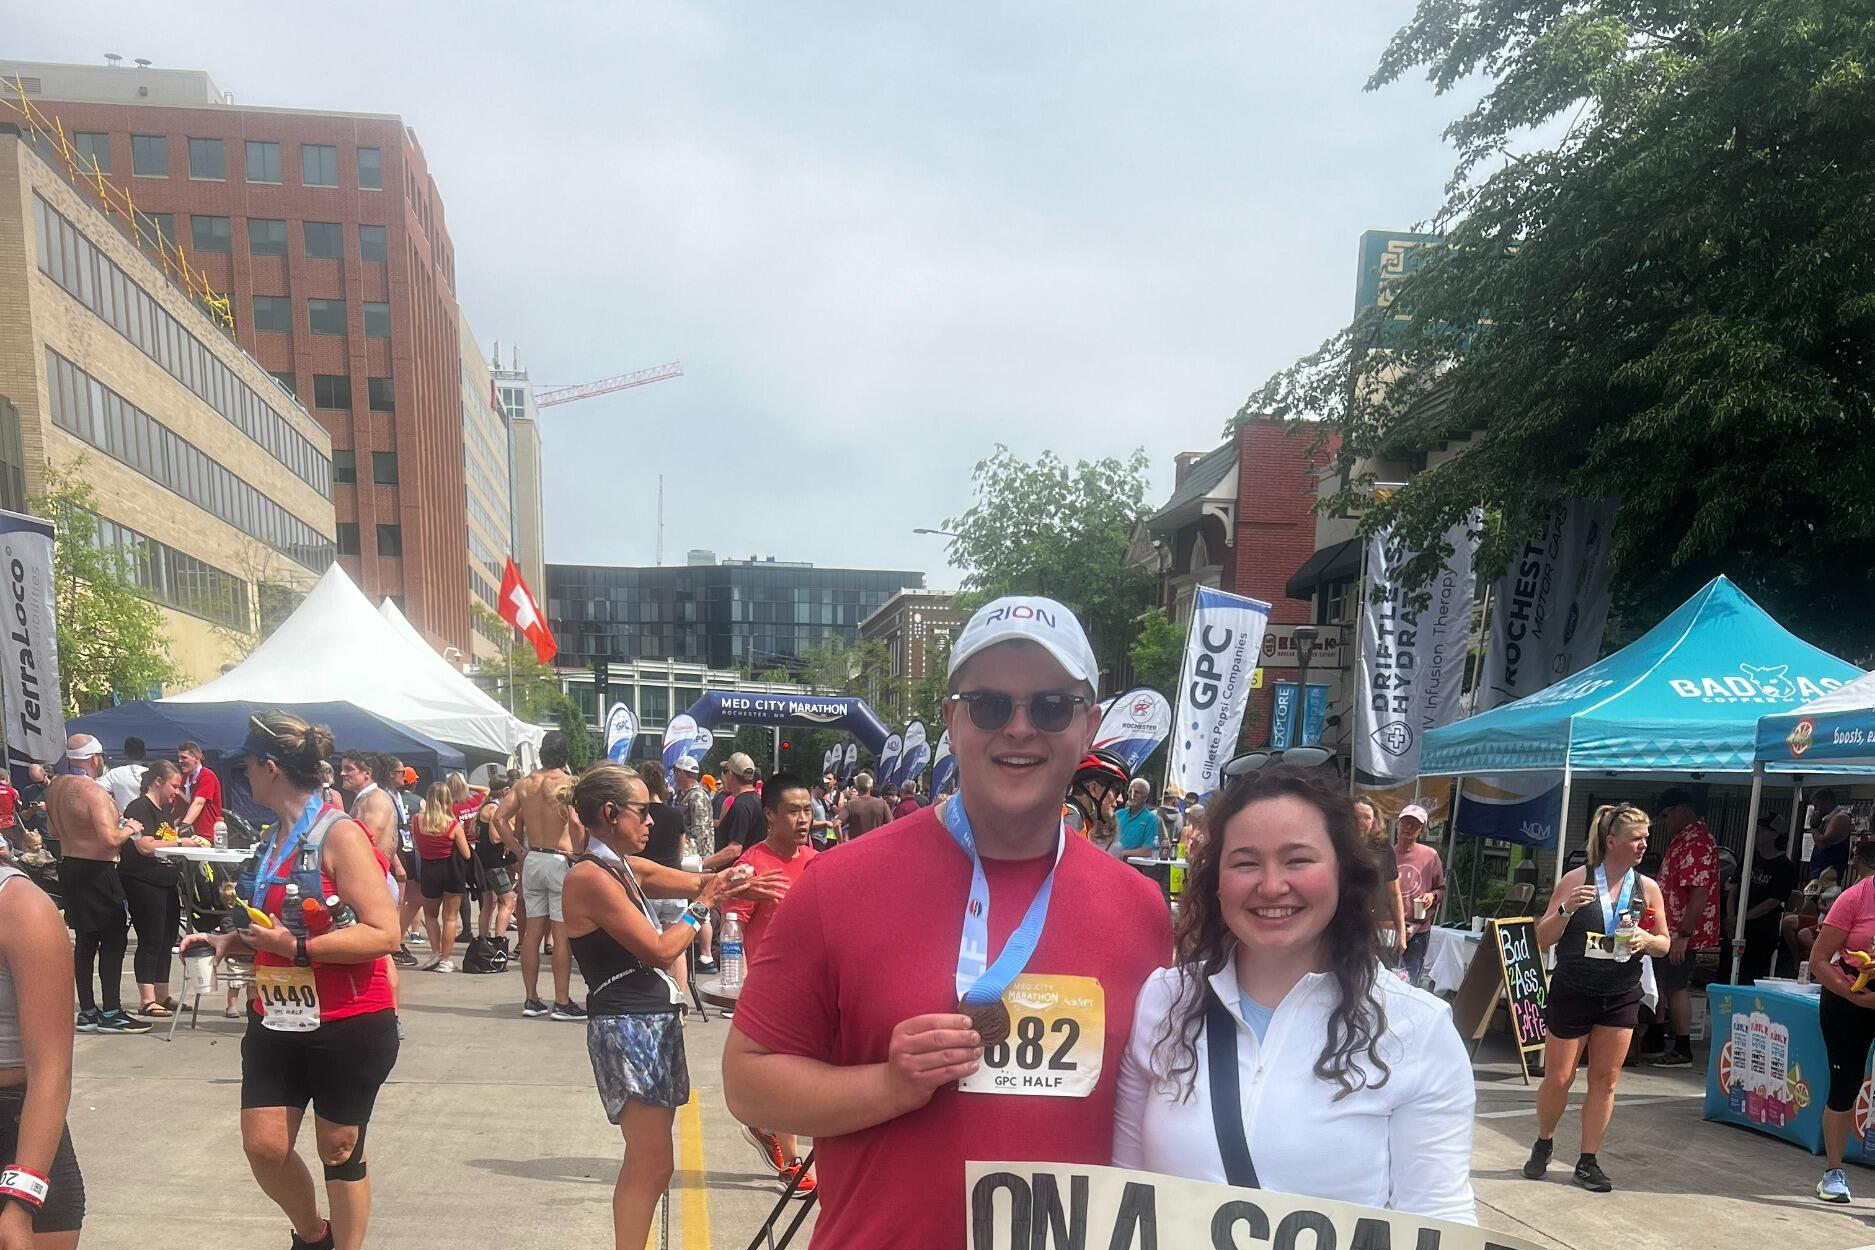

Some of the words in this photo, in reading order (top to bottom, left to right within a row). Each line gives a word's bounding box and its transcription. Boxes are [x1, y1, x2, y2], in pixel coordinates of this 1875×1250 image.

[986, 606, 1056, 628] RION
[1433, 567, 1458, 637] Therapy
[1505, 515, 1551, 687] ROCHEST
[1532, 566, 1554, 640] MOTOR
[11, 558, 42, 737] TerraLoco
[1190, 624, 1233, 711] GPC
[1424, 643, 1445, 710] Infusion
[1202, 736, 1220, 780] Gillette
[1213, 701, 1230, 738] Pepsi
[1222, 632, 1248, 698] Companies
[1668, 676, 1757, 698] BAD
[721, 697, 750, 709] MED
[755, 699, 786, 711] CITY
[789, 701, 848, 716] MARATHON
[1274, 688, 1290, 747] EXPLORE
[1122, 723, 1157, 731] ROCHESTER
[1521, 820, 1551, 838] MCM
[1500, 926, 1530, 966] Bad
[261, 984, 316, 1008] 1440
[1009, 990, 1058, 1002] MARATHON
[1514, 962, 1539, 999] Ass
[995, 1076, 1017, 1087] GPC
[1023, 1076, 1062, 1087] HALF
